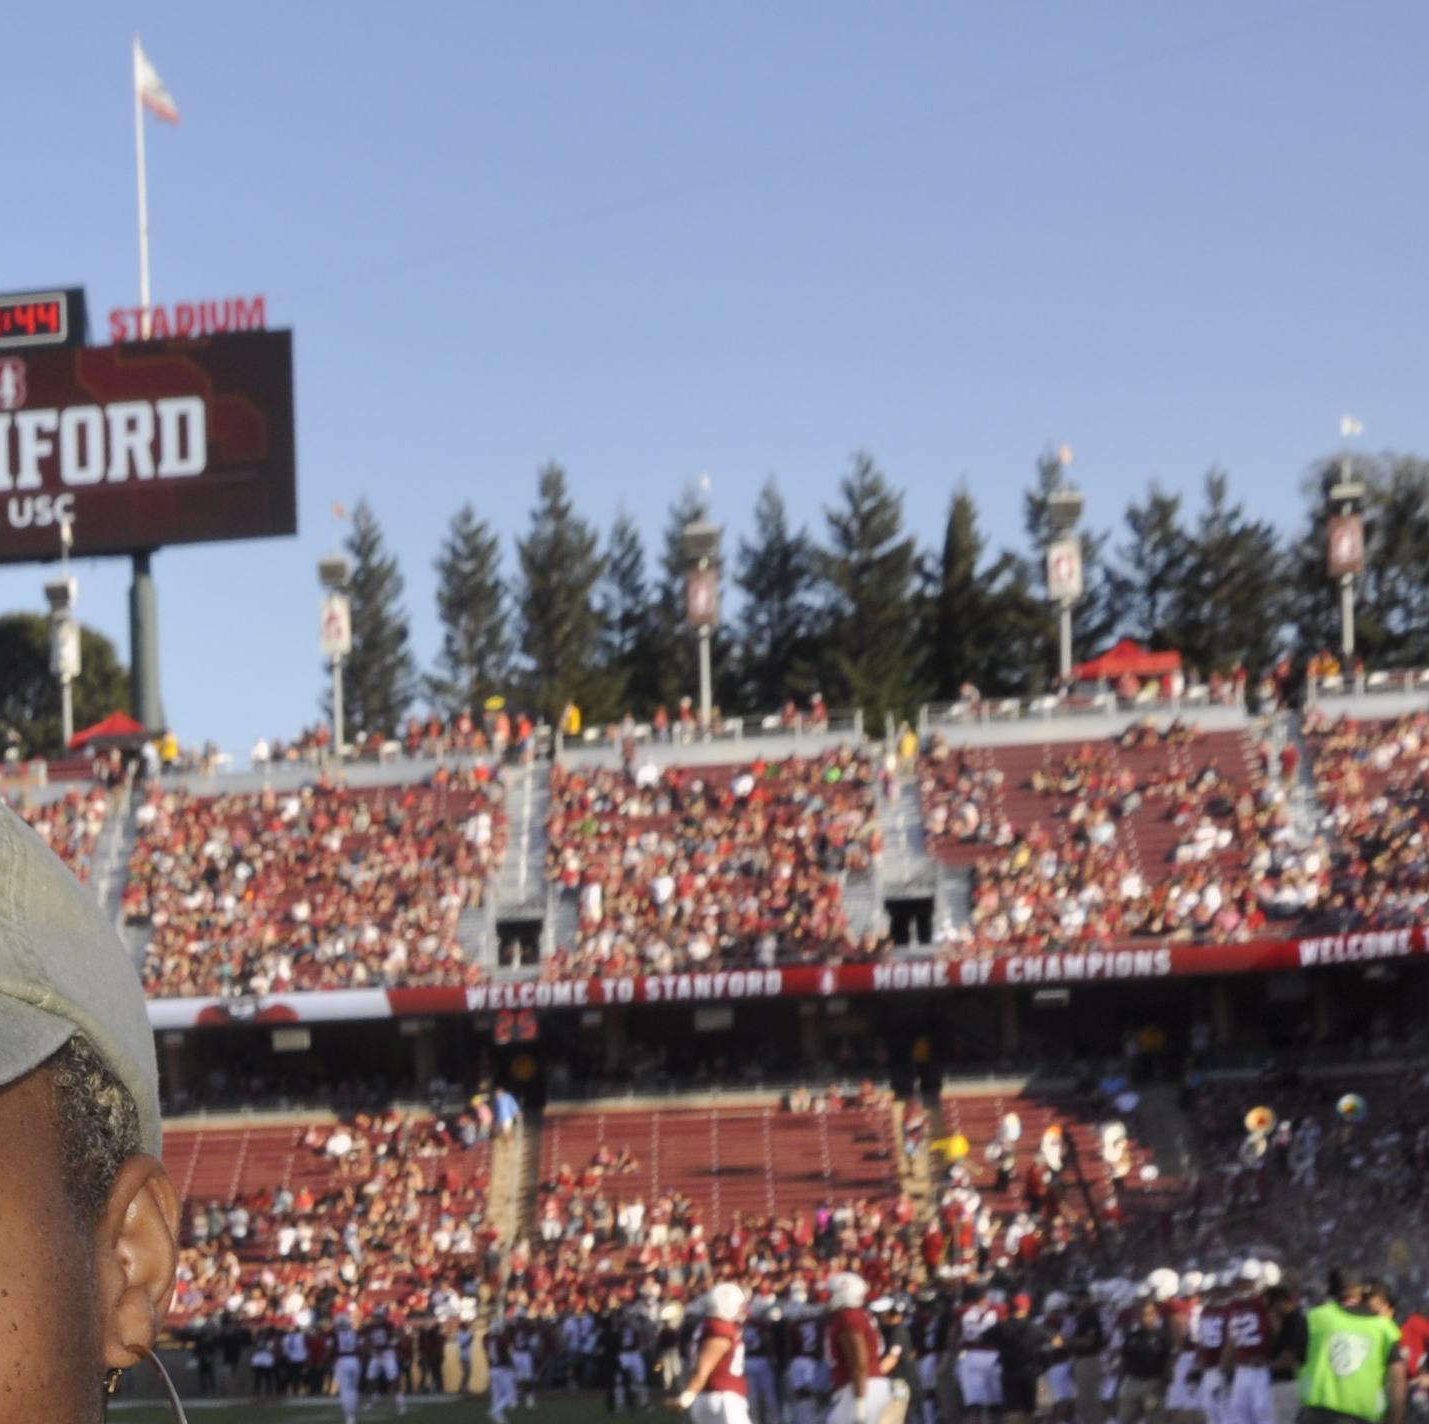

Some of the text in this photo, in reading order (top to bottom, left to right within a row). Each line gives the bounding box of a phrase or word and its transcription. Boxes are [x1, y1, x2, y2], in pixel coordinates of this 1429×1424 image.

[108, 295, 267, 342] STADIUM
[7, 493, 75, 529] USC
[873, 948, 1171, 989] HOME OF CHAMPIONS
[466, 969, 782, 1011] WELCOME TO STANFORD
